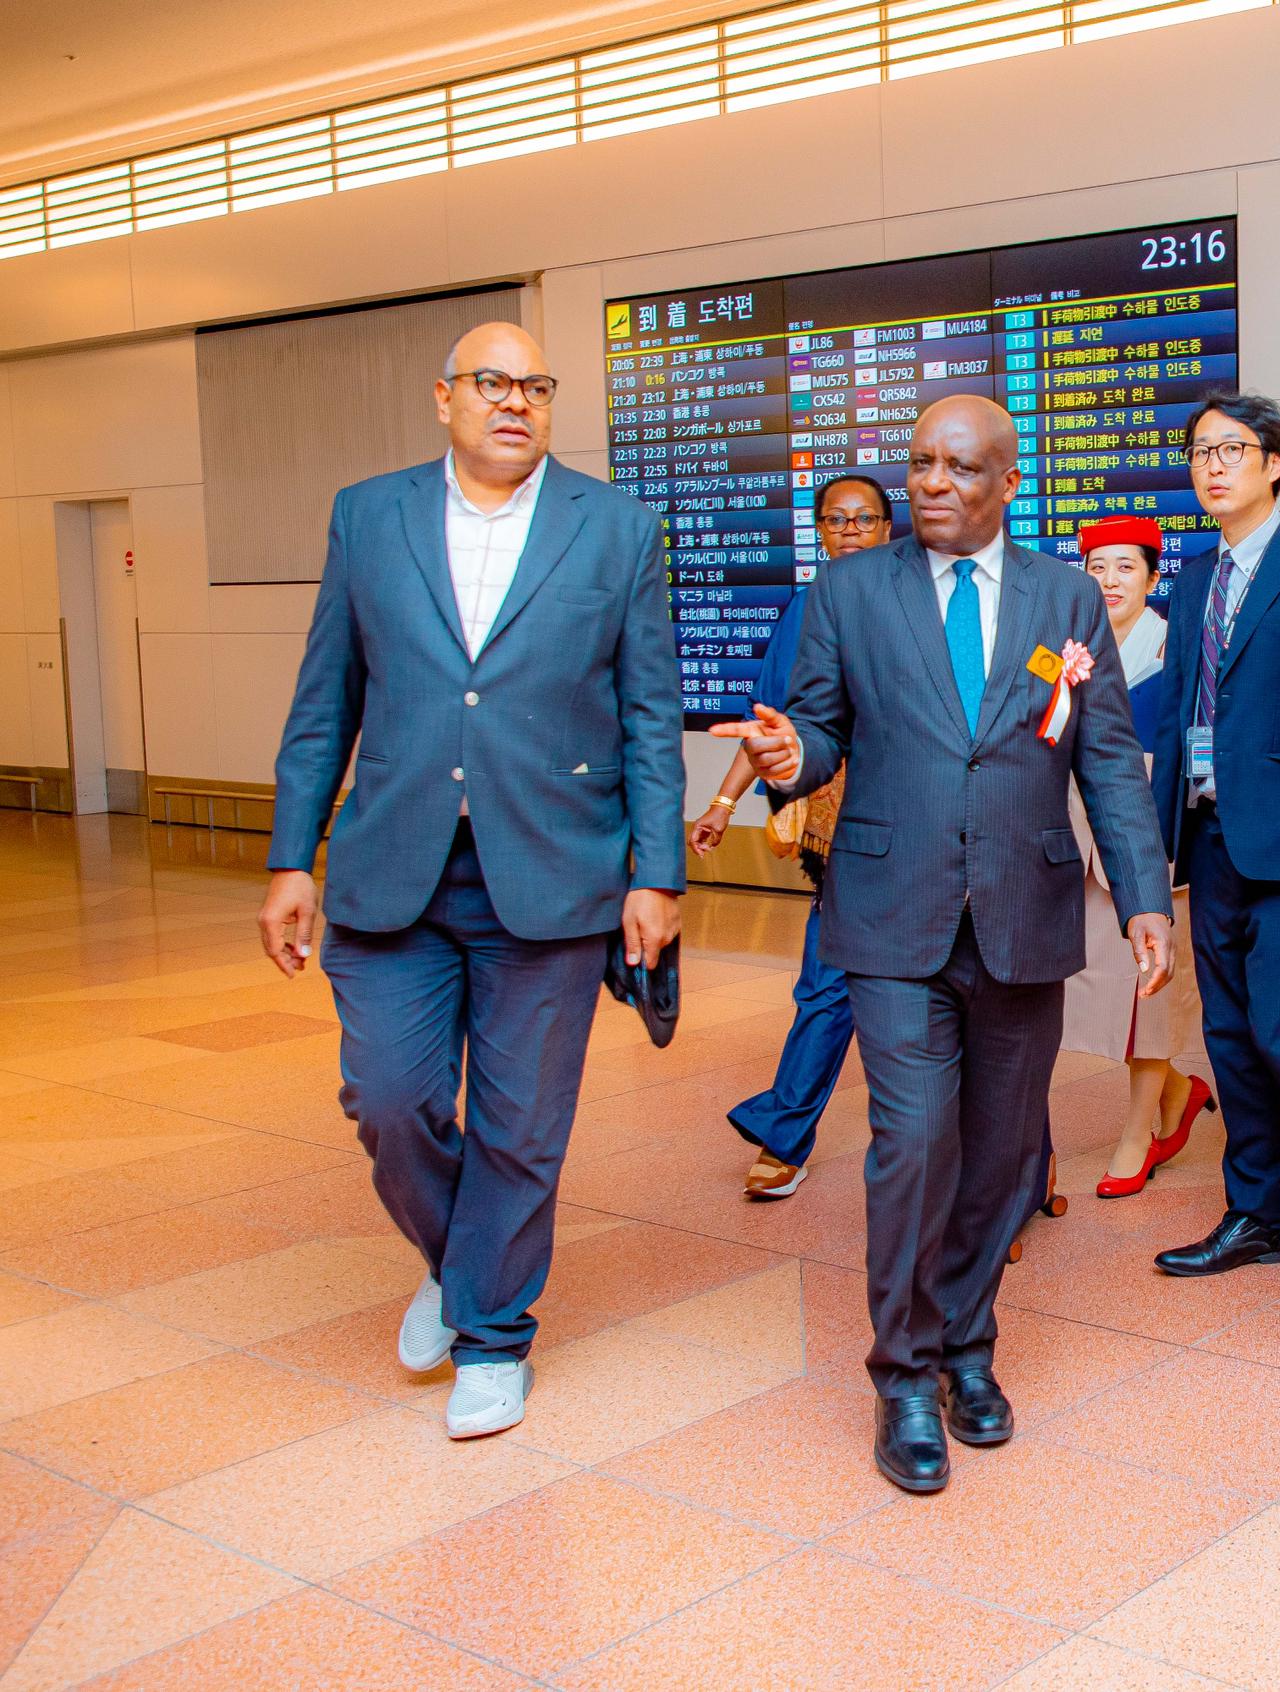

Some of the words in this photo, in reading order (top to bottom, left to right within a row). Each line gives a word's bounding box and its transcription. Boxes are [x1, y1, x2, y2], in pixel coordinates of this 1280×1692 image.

[1142, 230, 1226, 270] 23:16
[639, 305, 657, 332] 到
[668, 301, 686, 328] 着
[699, 293, 753, 323] 도착편
[1012, 314, 1026, 327] T3
[1052, 304, 1118, 324] 手荷物引渡中
[1122, 300, 1158, 316] 수하물
[1164, 294, 1200, 312] 인도중
[810, 336, 833, 350] JL86
[878, 327, 916, 342] FM1003
[947, 319, 988, 336] MU4184
[1013, 335, 1028, 347] T3
[1080, 326, 1104, 342] 지연
[811, 354, 845, 368] TG660
[878, 347, 917, 362] NH5966
[1014, 356, 1028, 368] T3
[1052, 346, 1118, 366] 手荷物引渡中
[1124, 342, 1160, 359] 수하물
[1165, 338, 1202, 356] 인도중
[612, 358, 634, 372] 20:05
[640, 355, 664, 368] 22:39
[612, 376, 636, 390] 21:10
[646, 373, 666, 386] 0:16
[671, 368, 704, 383] バンコク
[708, 366, 726, 380] 방콕
[812, 374, 849, 388] MU575
[878, 366, 914, 382] JL5792
[948, 360, 988, 376] FM3037
[1014, 376, 1028, 388] T3
[1053, 368, 1118, 387] 手荷物引渡中
[1124, 364, 1160, 381] 수하물
[1166, 360, 1202, 378] 인도중
[613, 395, 636, 408] 21:20
[642, 392, 666, 404] 23:12
[813, 393, 846, 408] CX542
[880, 386, 917, 403] QR5842
[1015, 396, 1029, 410] T3
[1053, 392, 1098, 408] 到着済み
[1103, 389, 1126, 404] 도착
[1132, 387, 1156, 402] 완료
[614, 412, 638, 425] 21:35
[643, 410, 666, 422] 22:30
[672, 406, 690, 420] 香港
[813, 412, 847, 428] SQ634
[880, 407, 918, 421] NH6256
[1016, 419, 1030, 432] T3
[1054, 414, 1098, 430] 到着済み
[1103, 412, 1126, 426] 도착
[1132, 410, 1156, 424] 완료
[615, 430, 638, 443] 21:55
[644, 428, 667, 440] 22:03
[728, 420, 762, 434] 싱가포르
[814, 433, 848, 447] NH878
[880, 428, 916, 442] TG610
[1054, 434, 1120, 451] 手荷物引渡中
[1125, 430, 1160, 446] 수하물
[615, 449, 638, 462] 22:15
[644, 447, 667, 460] 22:23
[674, 443, 707, 456] バンコク
[710, 442, 728, 454] 방콕
[814, 453, 846, 466] EK312
[1017, 460, 1030, 472] T3
[1054, 455, 1120, 472] 手荷物引渡中
[1126, 451, 1160, 467] 수하물
[616, 467, 638, 480] 22:25
[644, 465, 668, 478] 22:55
[675, 462, 699, 475] ドバイ
[702, 460, 728, 474] 두바이
[645, 482, 668, 494] 22:45
[675, 479, 736, 493] クアラルンプール
[1082, 476, 1106, 492] 도착
[1018, 501, 1031, 514] T3
[1133, 496, 1158, 510] 완료
[676, 516, 694, 530] 香港
[1018, 522, 1032, 534] T3
[1056, 540, 1080, 554] 共同
[679, 570, 704, 582] ドーハ
[707, 570, 724, 582] 도하
[678, 591, 704, 602] マニラ
[708, 590, 733, 602] 마닐라
[724, 608, 780, 620] 타이베이(TPE)
[680, 644, 723, 656] ホーチミン
[682, 662, 700, 674] 香港
[682, 680, 724, 692] 北京・首都
[683, 698, 700, 710] 天津
